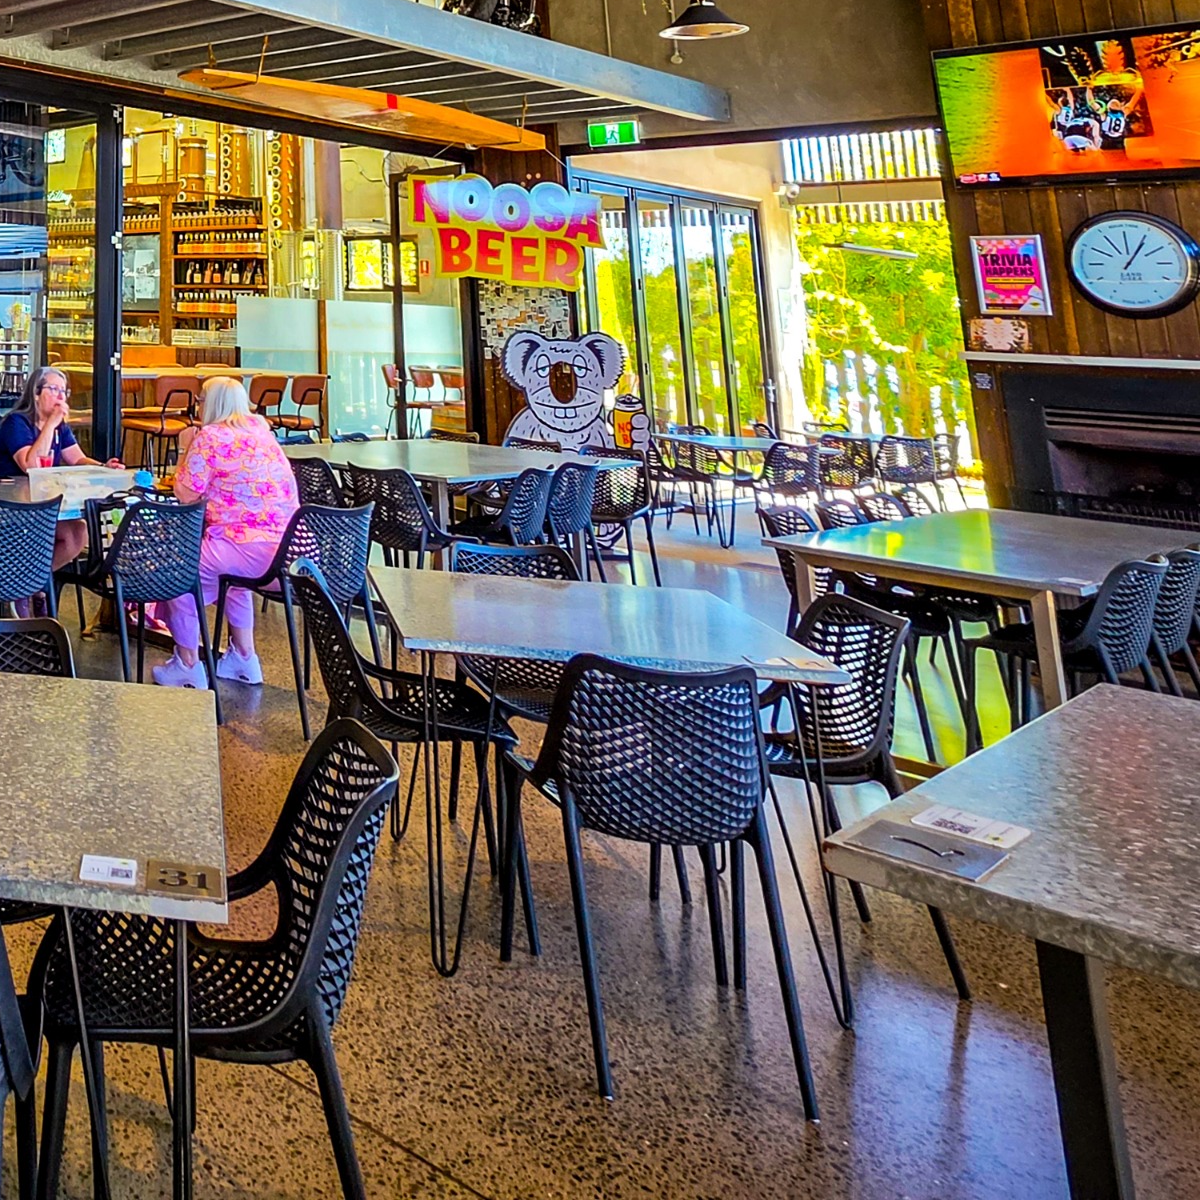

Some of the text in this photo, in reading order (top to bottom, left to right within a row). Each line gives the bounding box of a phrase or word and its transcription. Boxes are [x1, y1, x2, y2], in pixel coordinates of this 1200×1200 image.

[1110, 117, 1122, 133] 18
[413, 177, 602, 245] NOOSA
[438, 227, 580, 287] BEER
[980, 253, 1032, 267] TRIVIA
[985, 267, 1034, 276] HAPPENS
[158, 867, 209, 890] 31
